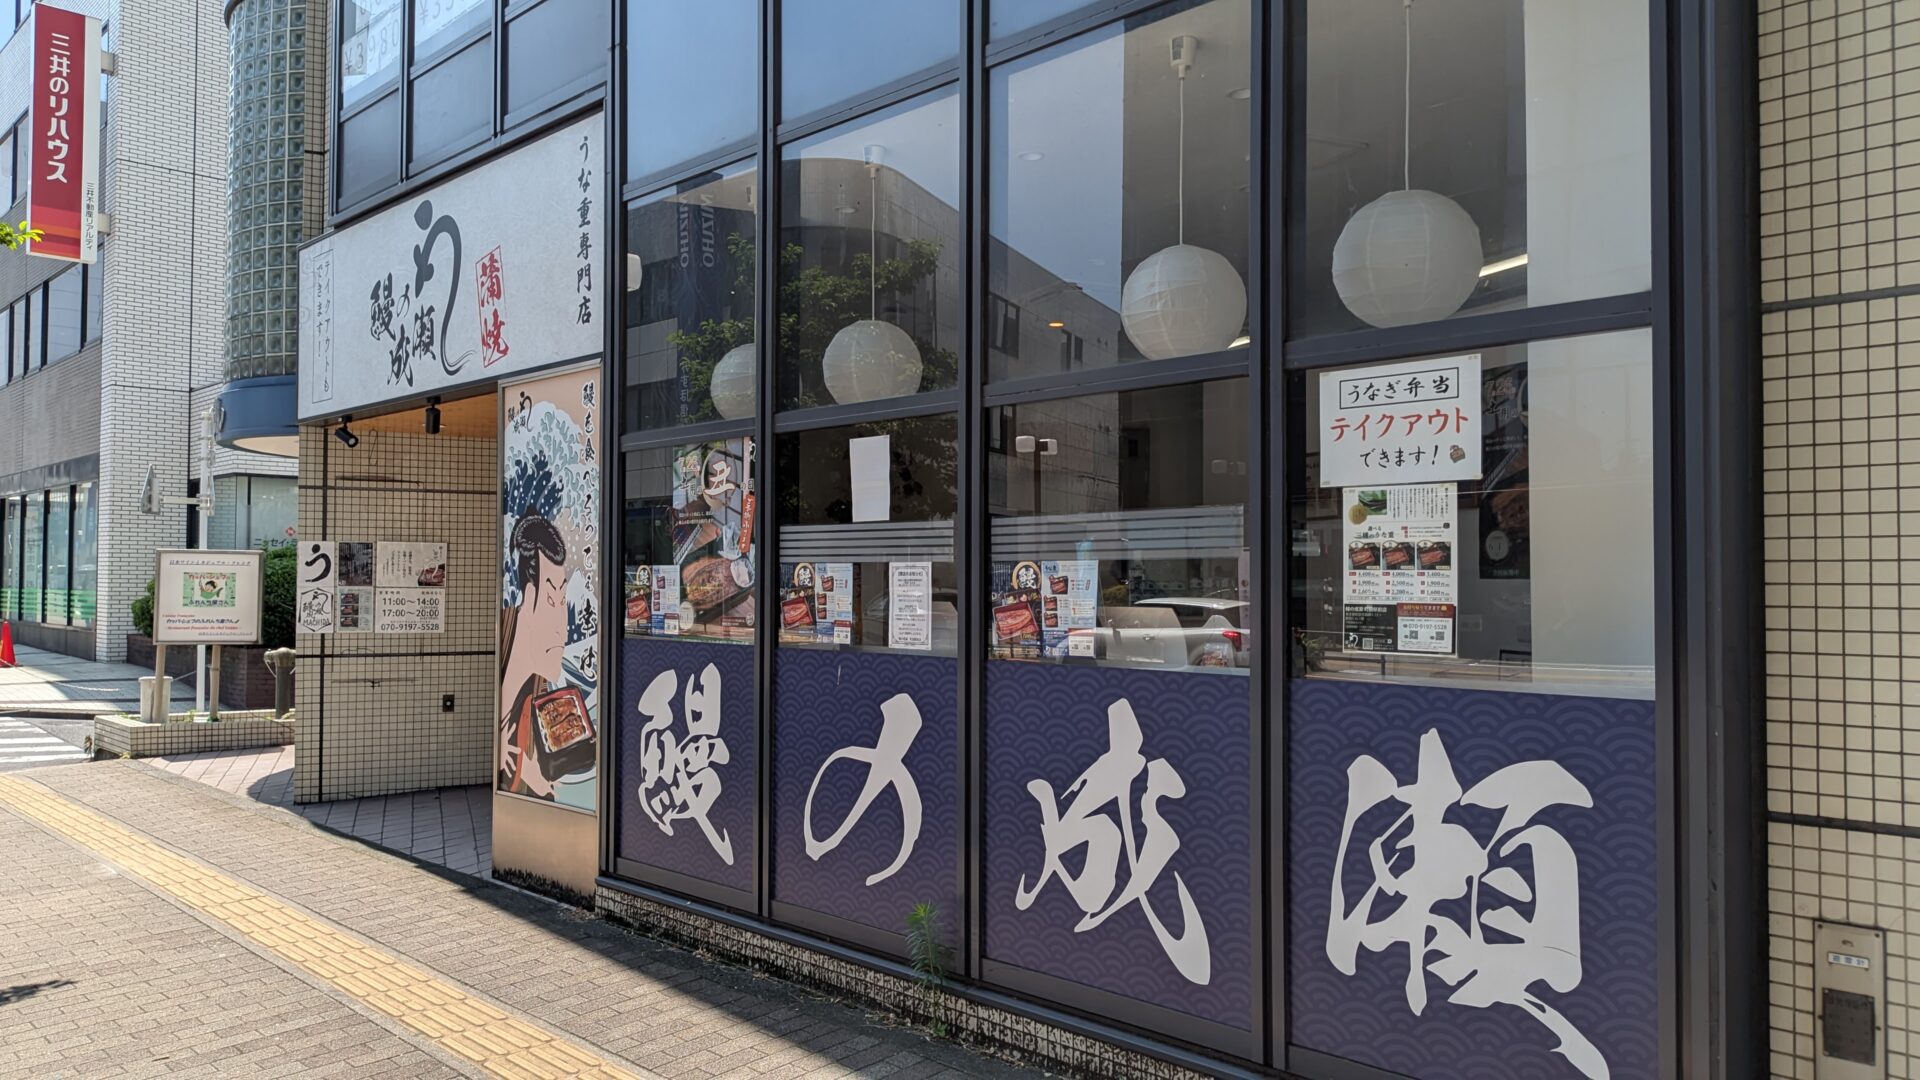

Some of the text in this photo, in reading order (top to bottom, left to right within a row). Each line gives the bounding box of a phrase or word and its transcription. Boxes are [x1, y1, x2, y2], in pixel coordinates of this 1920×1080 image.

[46, 32, 71, 184] 三井のリハウス
[85, 182, 96, 250] 三井不動産リアルティ
[576, 136, 592, 326] うな重専門店
[323, 260, 331, 393] テイクアウトも
[370, 272, 437, 388] 鰻の成瀬
[479, 253, 510, 362] 蒲焼
[1347, 374, 1451, 404] うなぎ弁当
[1330, 406, 1469, 442] テイクアウト
[1359, 445, 1439, 468] できます!
[304, 543, 332, 583] う
[380, 623, 440, 631] 070-9197-5528
